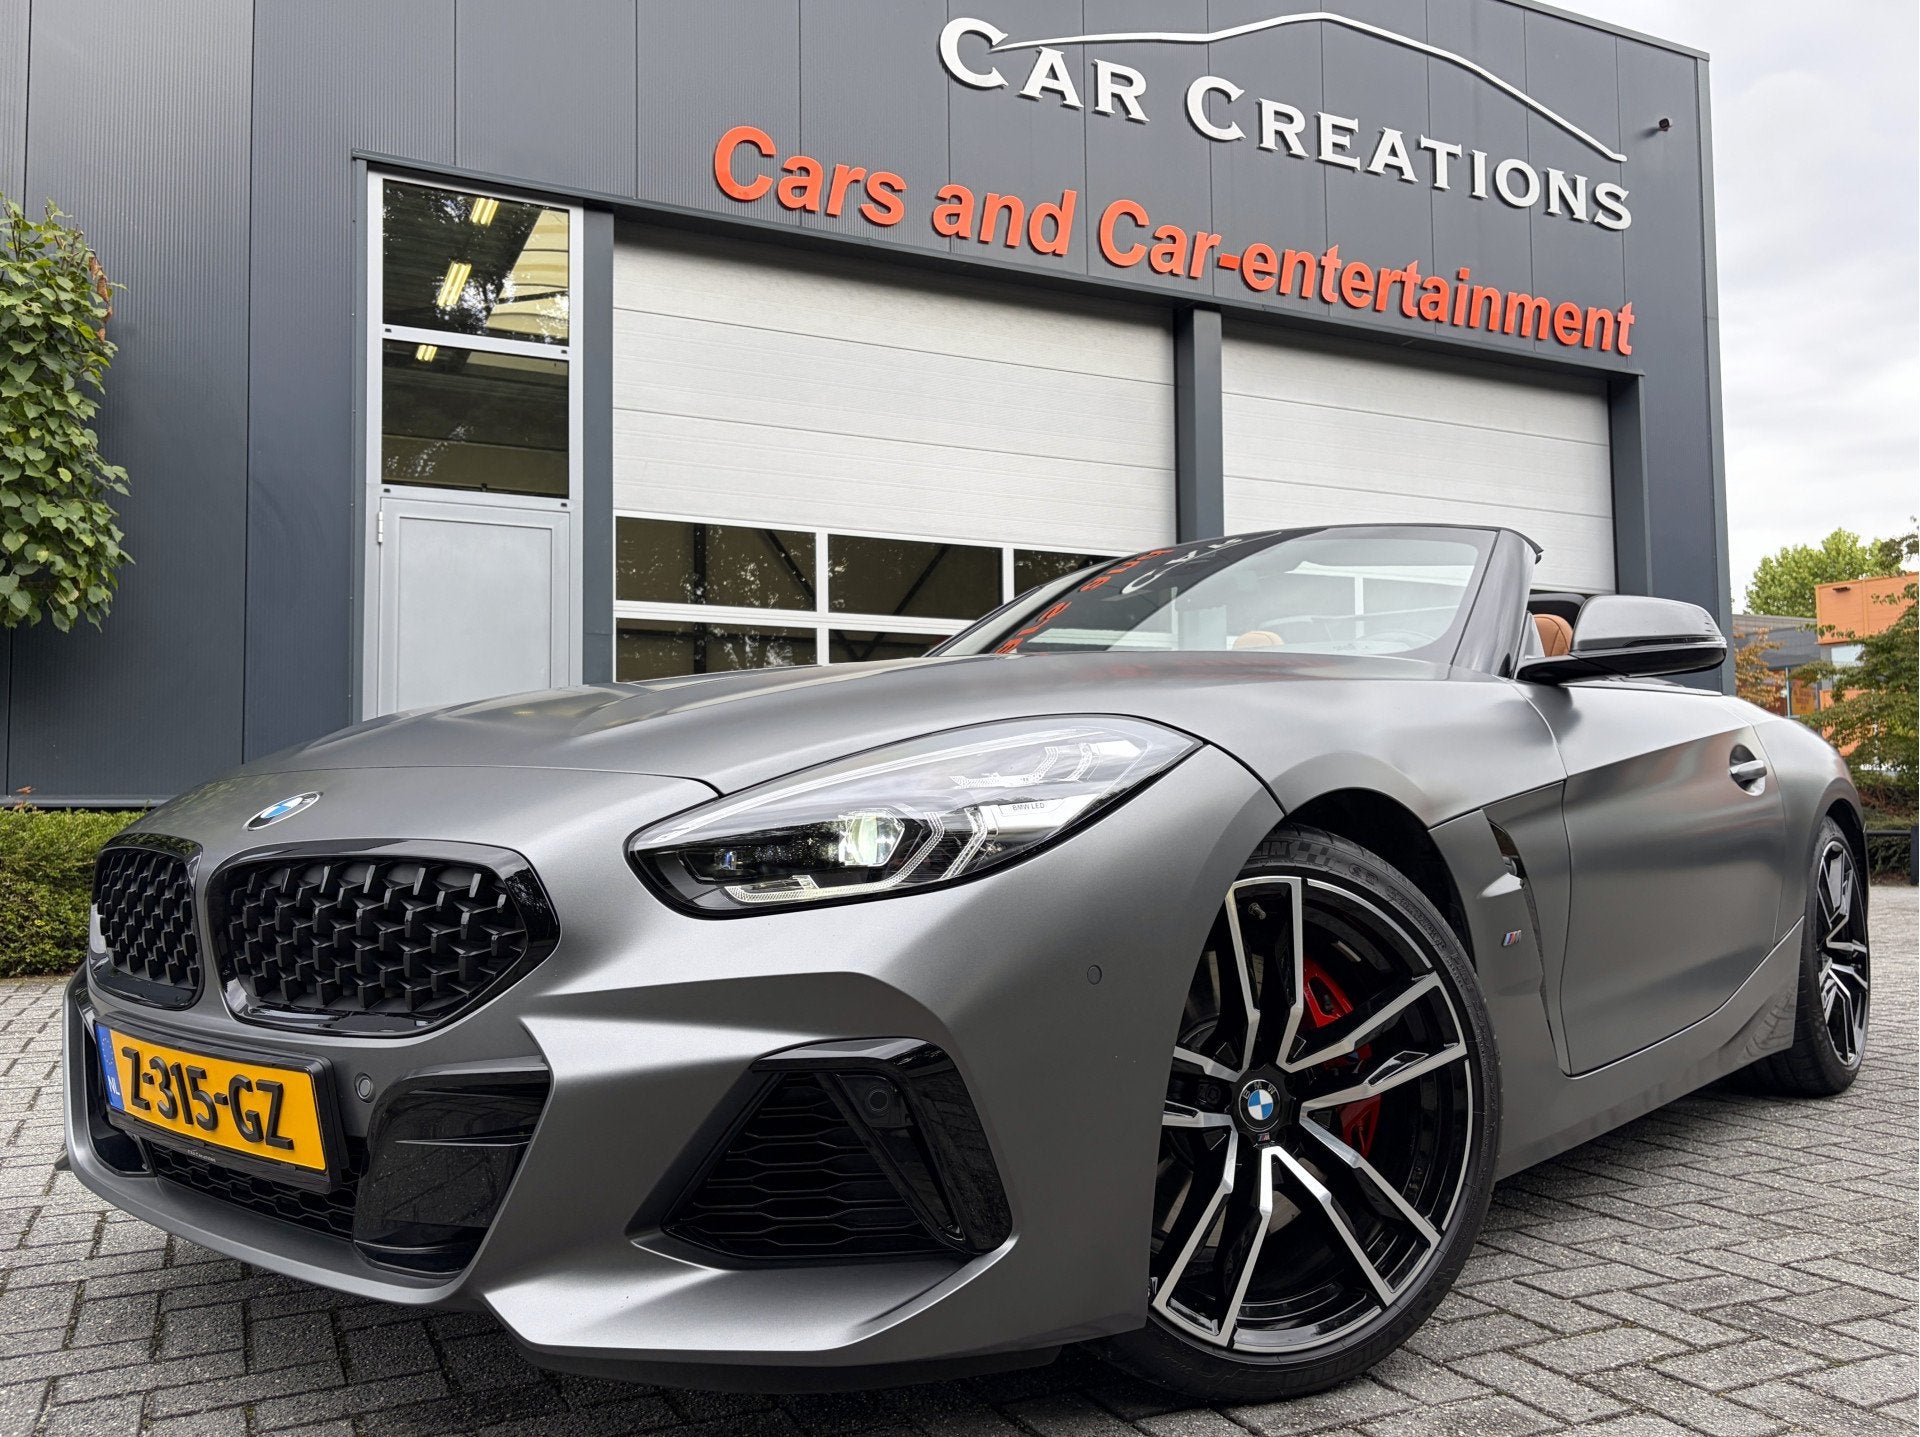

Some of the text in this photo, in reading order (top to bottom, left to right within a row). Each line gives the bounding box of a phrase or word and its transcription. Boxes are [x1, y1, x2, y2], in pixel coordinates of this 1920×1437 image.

[939, 16, 1634, 231] CAR CREATIONS
[713, 125, 1635, 356] Cars and Car-entertainment
[1031, 802, 1045, 810] LED
[107, 1074, 121, 1096] NL
[121, 1046, 294, 1150] Z-315-GZ
